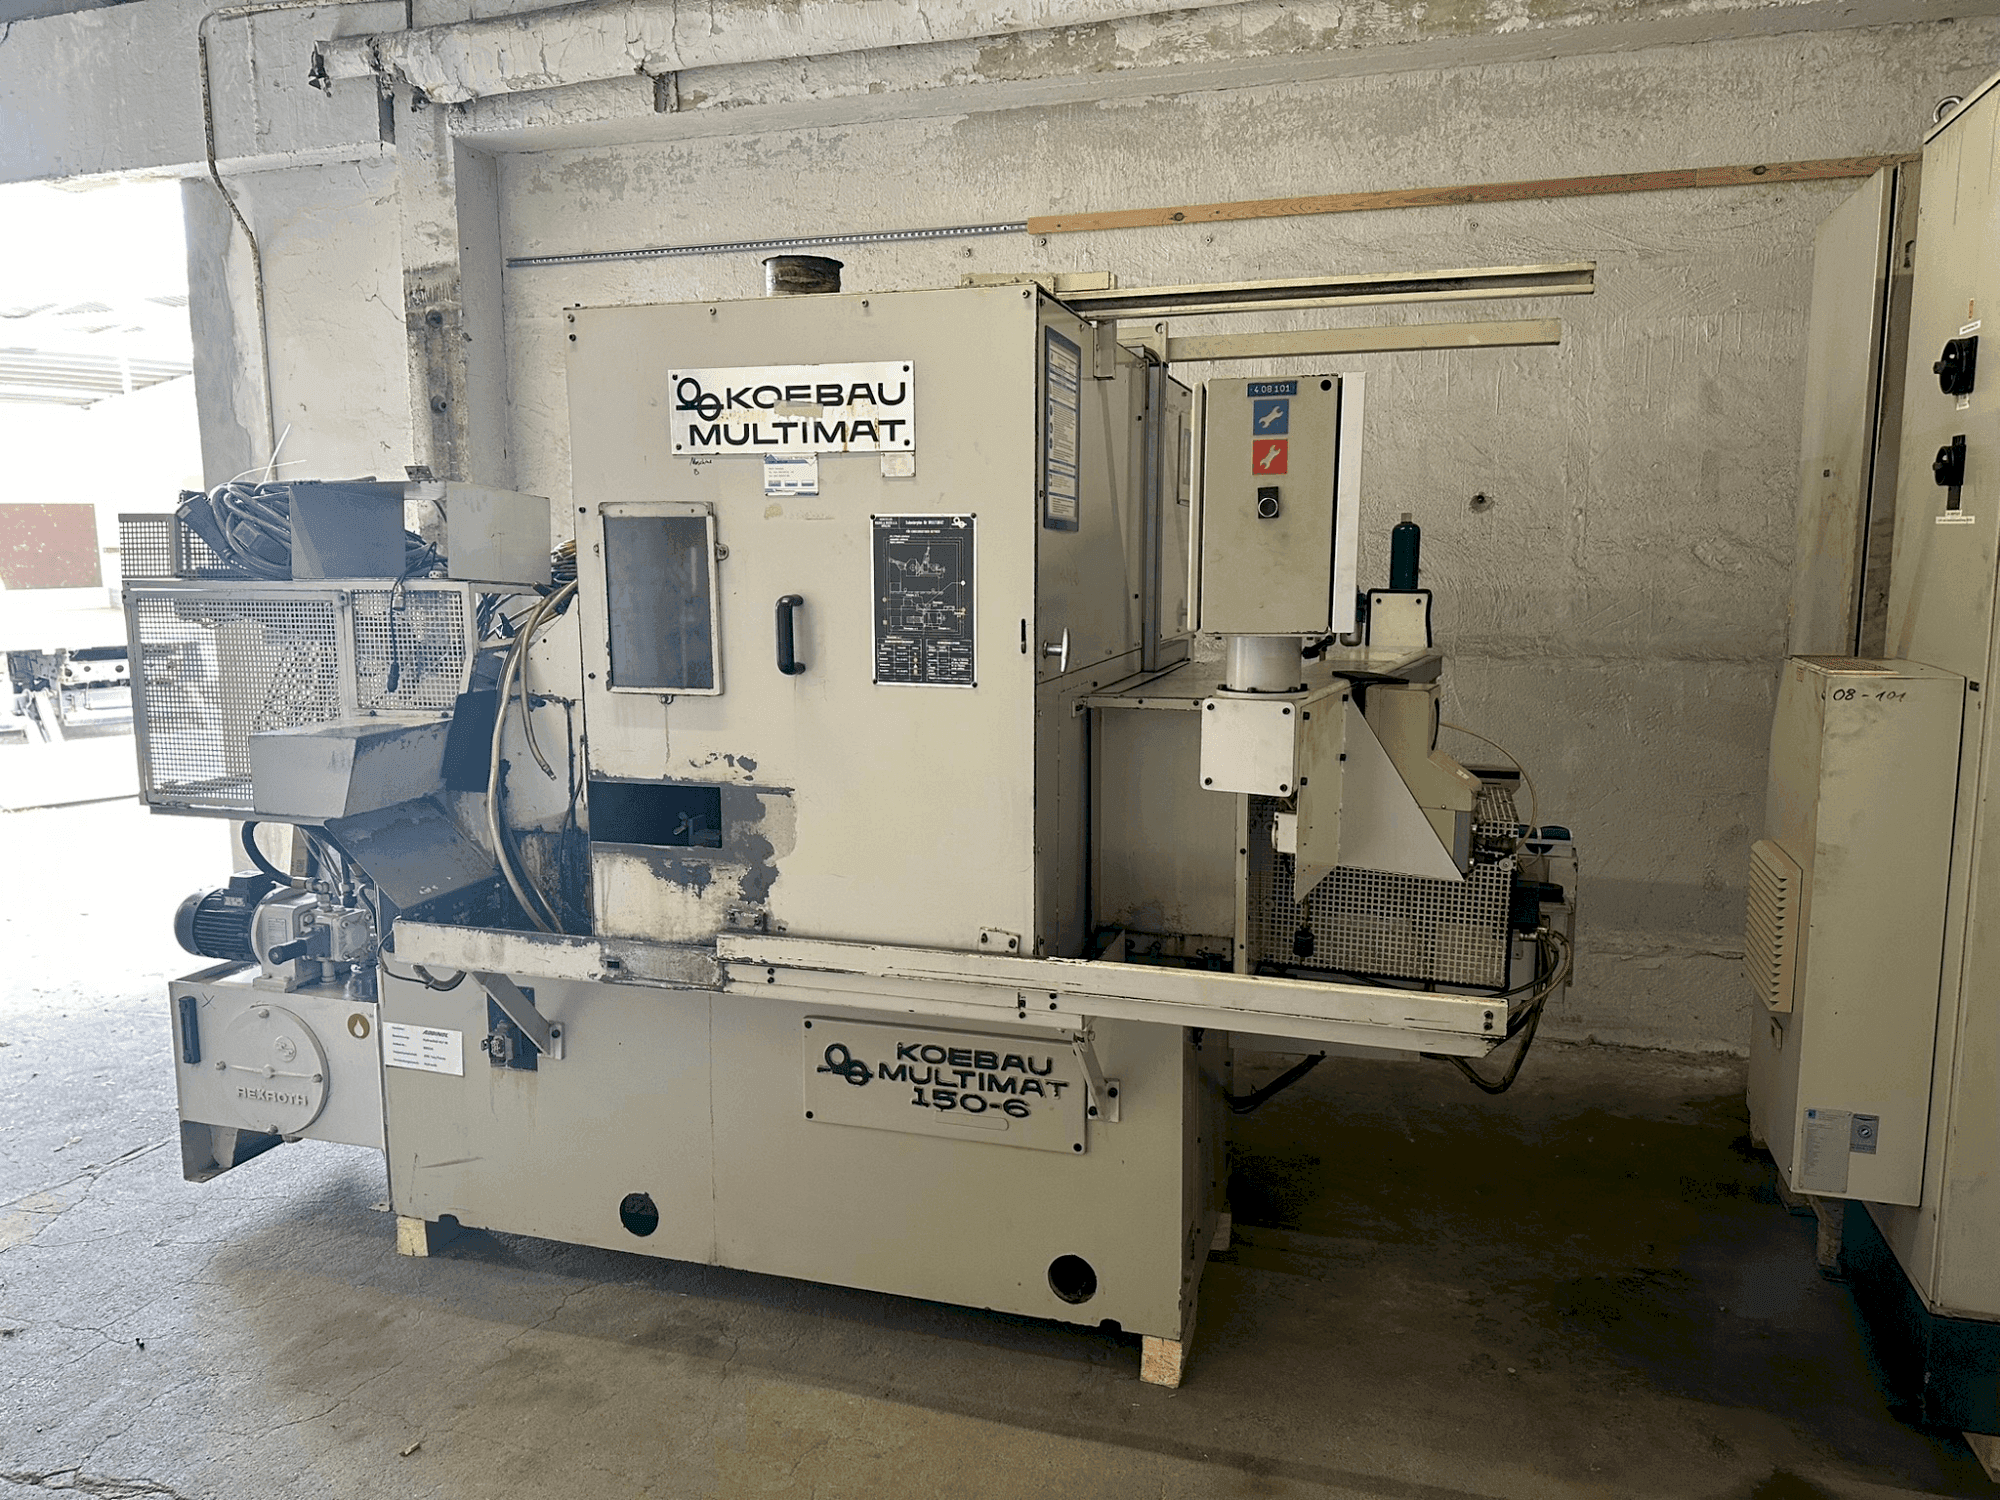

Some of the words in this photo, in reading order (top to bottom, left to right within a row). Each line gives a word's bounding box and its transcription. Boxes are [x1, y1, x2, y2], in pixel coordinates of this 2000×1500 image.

[726, 381, 906, 410] KOEBAU
[1261, 385, 1273, 393] 08
[689, 419, 906, 446] MULTIMAT
[1832, 688, 1857, 701] 08
[896, 1042, 1053, 1077] KOEBAU
[878, 1062, 1070, 1100] MULTIMAT
[237, 1086, 309, 1107] REXROTH
[911, 1086, 1032, 1118] 150-6
